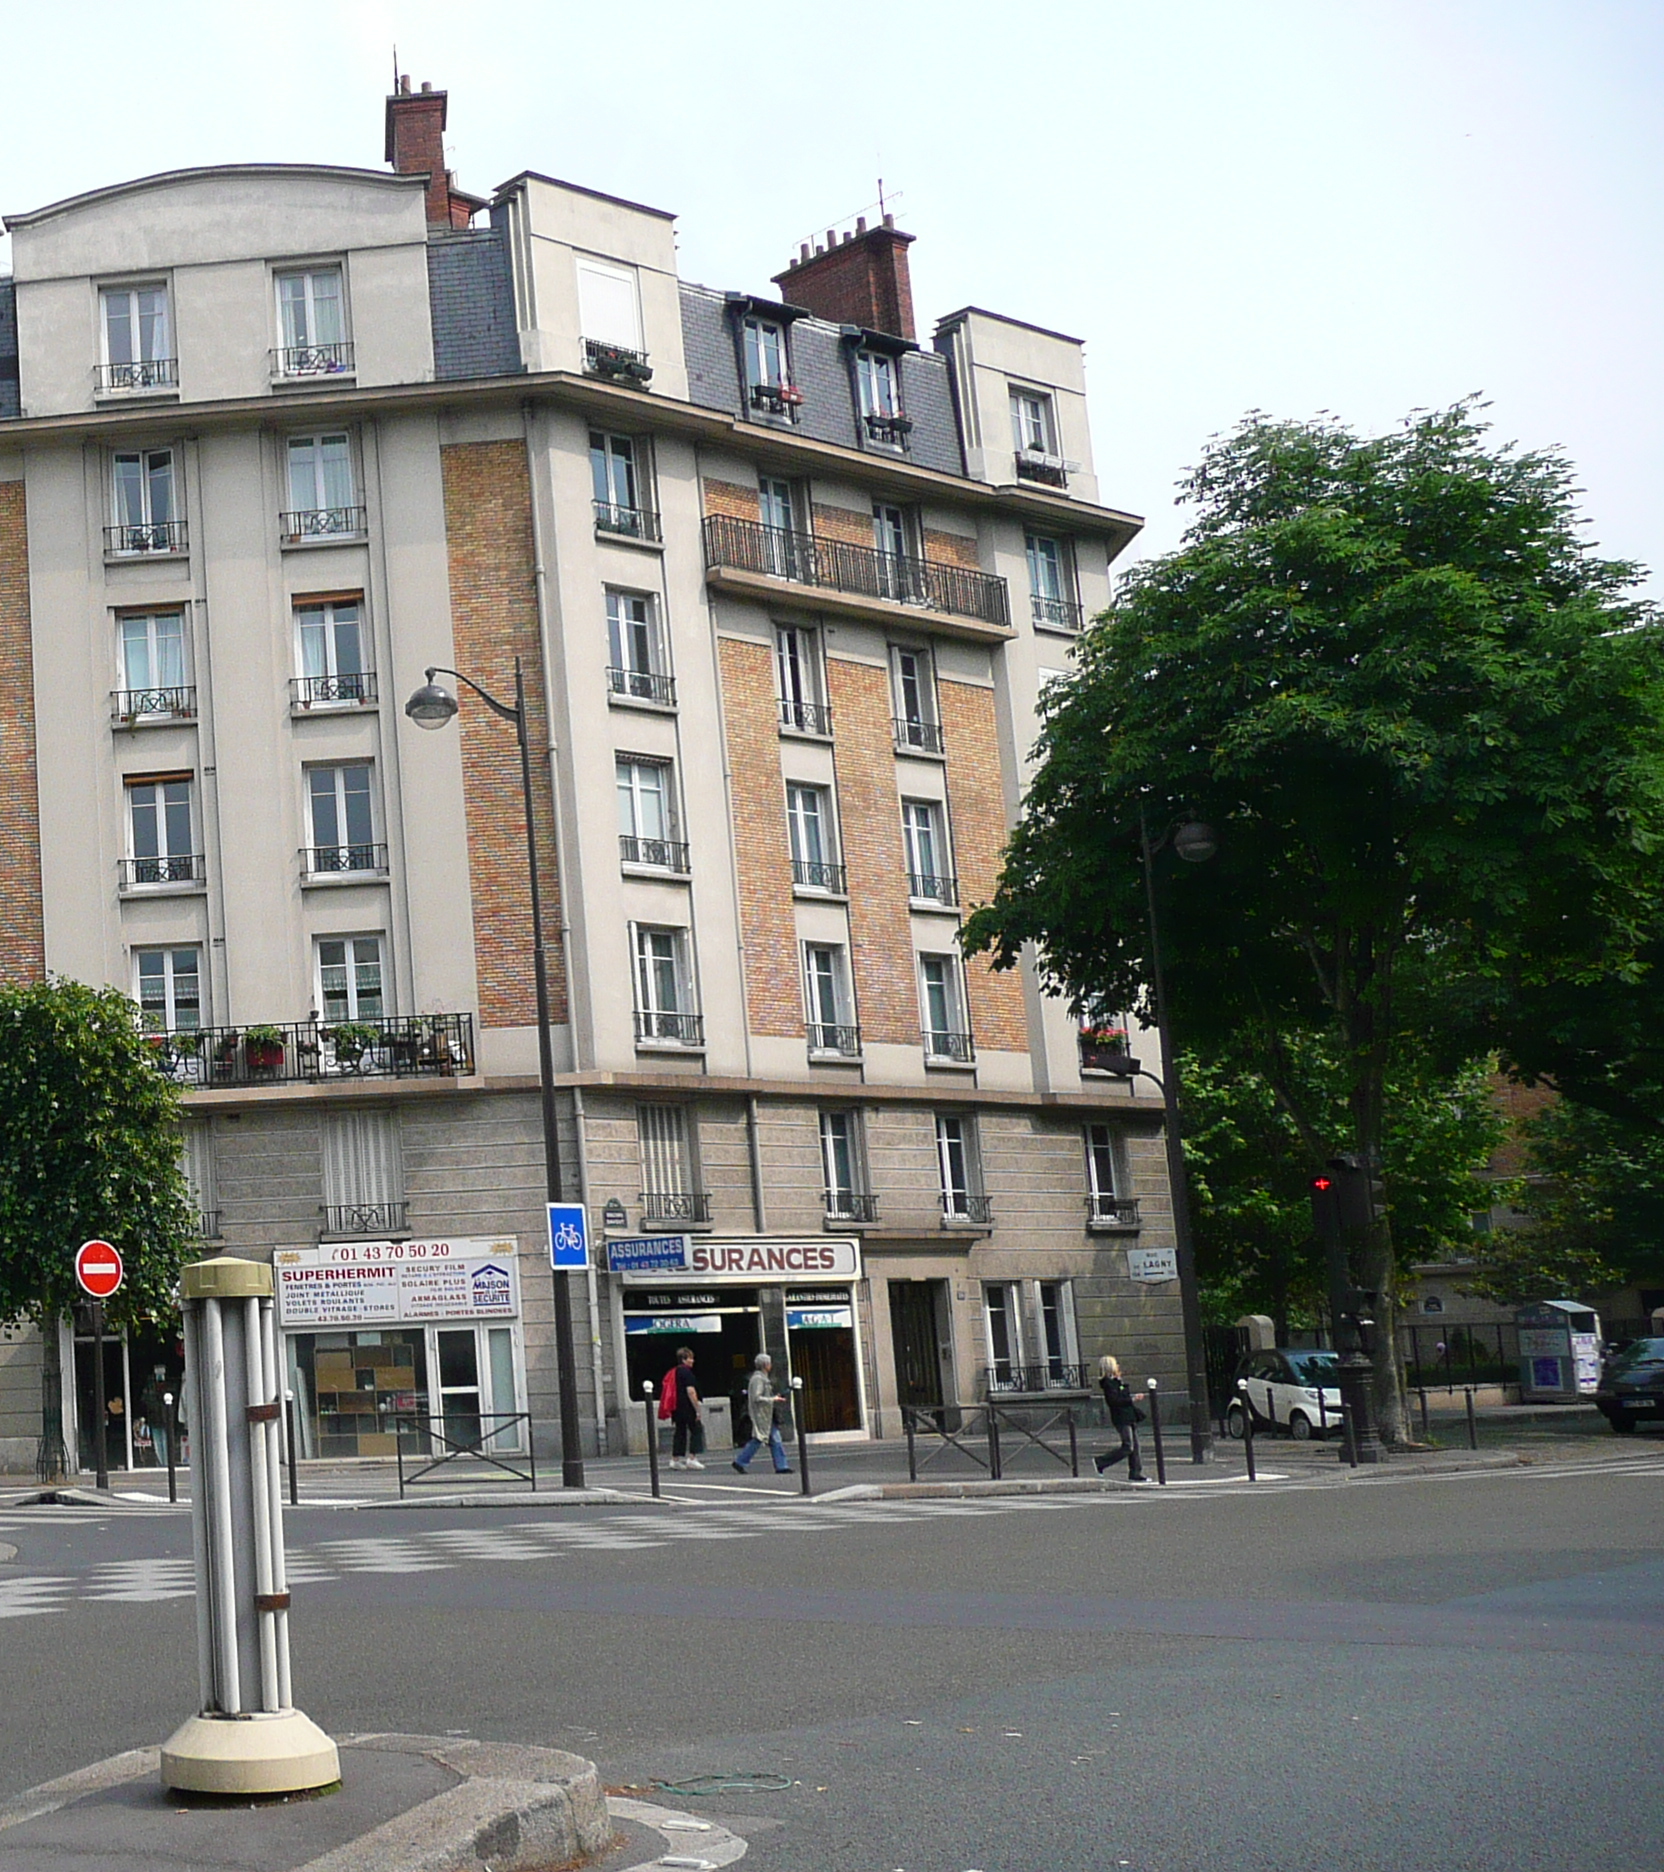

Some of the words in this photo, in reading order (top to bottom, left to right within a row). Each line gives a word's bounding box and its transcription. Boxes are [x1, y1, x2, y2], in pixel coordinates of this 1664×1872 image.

[341, 1248, 357, 1260] 01
[363, 1247, 380, 1260] 43
[386, 1246, 403, 1258] 70
[409, 1244, 426, 1257] 50
[431, 1243, 449, 1256] 20
[611, 1239, 682, 1259] ASSURANCES
[651, 1247, 835, 1272] SURANCES
[1143, 1260, 1171, 1268] LAGNY
[282, 1267, 396, 1281] SUPERHERMIT
[405, 1265, 441, 1273] SECURY
[402, 1279, 439, 1288] SOLAIRE
[473, 1280, 510, 1290] MAISON
[322, 1305, 357, 1313] VITRAGE
